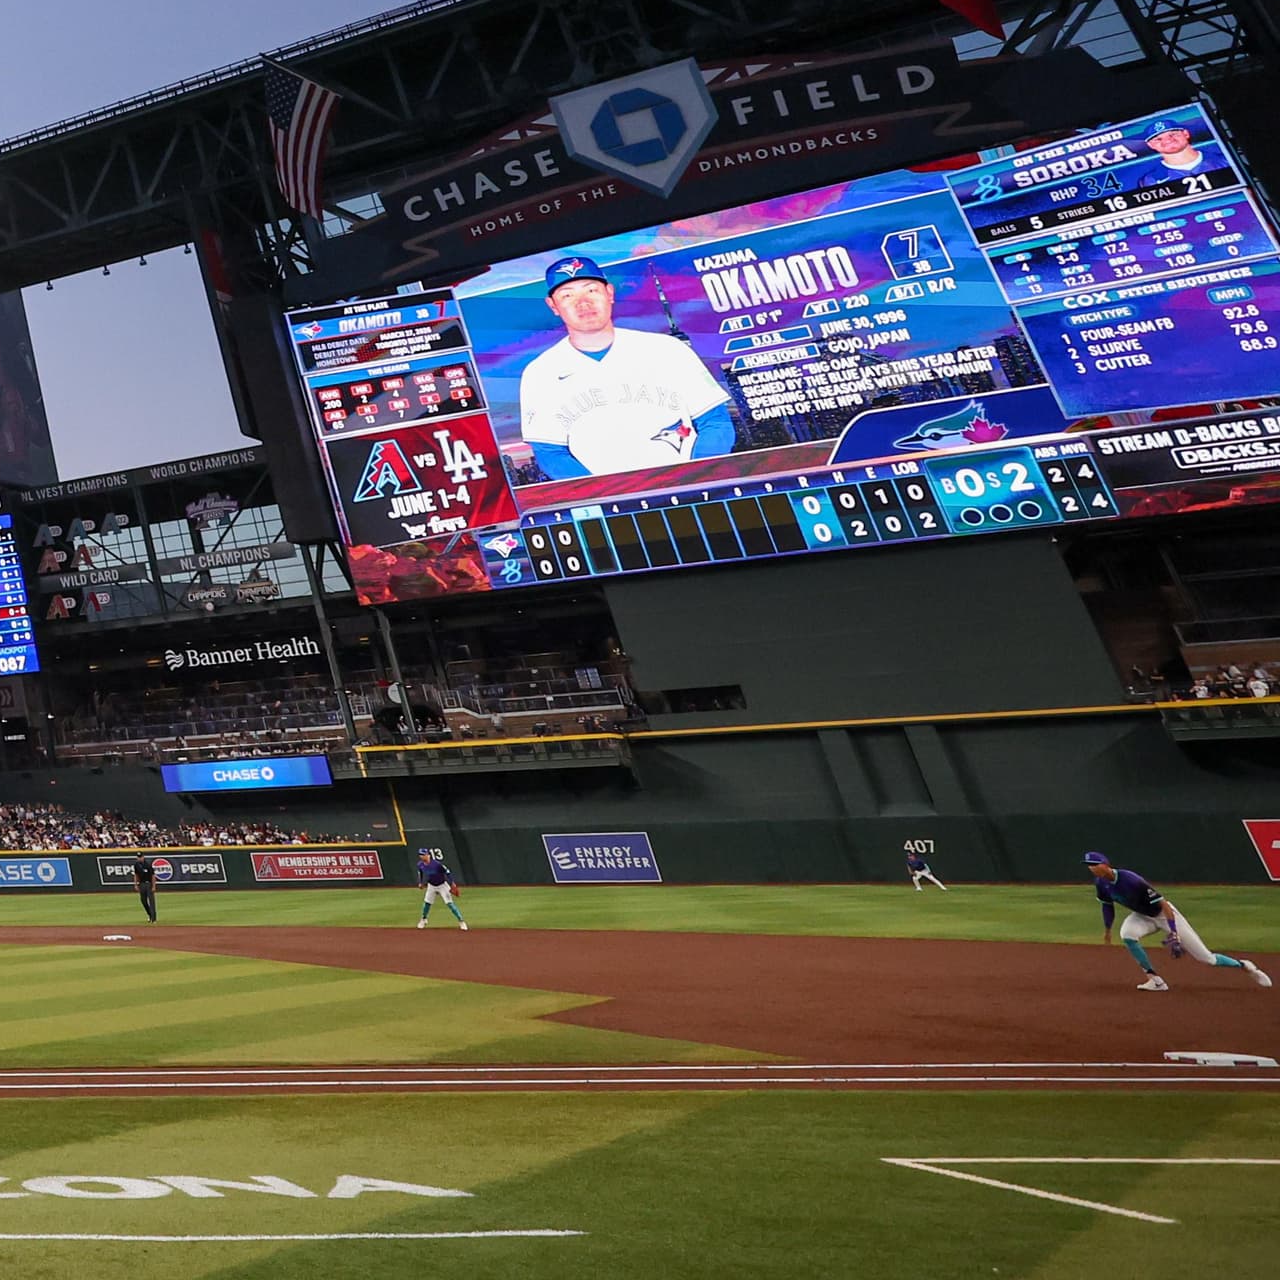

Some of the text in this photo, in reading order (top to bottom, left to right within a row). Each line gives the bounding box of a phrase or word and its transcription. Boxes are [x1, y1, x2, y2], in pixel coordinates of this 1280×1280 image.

[403, 64, 936, 222] CHASE FIELD
[1012, 130, 1123, 167] ON THE MOUND
[470, 128, 878, 237] HOME OF THE DIAMONDBACKS
[1013, 145, 1138, 188] SOROKA
[1049, 172, 1123, 203] RHP 34
[990, 174, 1213, 236] BALLS 5 STRIKES 16 TOTAL 21
[1057, 212, 1155, 241] THIS SEASON
[693, 248, 757, 273] KAZUMA
[898, 232, 920, 259] 7
[701, 246, 859, 313] OKAMOTO
[912, 260, 931, 274] 3B
[1063, 254, 1196, 288] 12.23 3.06 1.08
[1063, 267, 1253, 309] COX PITCH SEQUENCE
[1070, 289, 1245, 324] PITCH TYPE MPH
[1061, 304, 1259, 345] 1 FOUR-SEAM FB 92.8
[1067, 320, 1268, 359] 2 SLURVE 79.6
[744, 328, 910, 367] HOMETOWN GOJO, JAPAN
[1075, 336, 1278, 374] 3 CUTTER 88.9
[742, 346, 998, 398] SIGNED BY THE BLUE JAYS THIS YEAR AFTER
[746, 359, 993, 409] SPENDING 11 SEASONS WITH THE YOMIURI
[1097, 420, 1262, 455] STREAM D-BACKS
[150, 451, 255, 479] WORLD CHAMPIONS
[941, 461, 1035, 498] B 0 S 2
[21, 475, 128, 502] NL WEST CHAMPIONS
[388, 486, 471, 518] JUNE 1-4
[180, 547, 270, 570] NL CHAMPIONS
[60, 570, 119, 587] WILD CARD
[188, 636, 320, 668] Banner Health
[212, 767, 260, 781] CHASE
[278, 856, 374, 866] MEMBERSHIPS ON SALE
[575, 847, 631, 857] ENERGY
[578, 858, 651, 869] TRANSFER
[903, 840, 935, 855] 407
[181, 864, 218, 874] PEPSI
[294, 867, 364, 876] TEXT 602.462.4600
